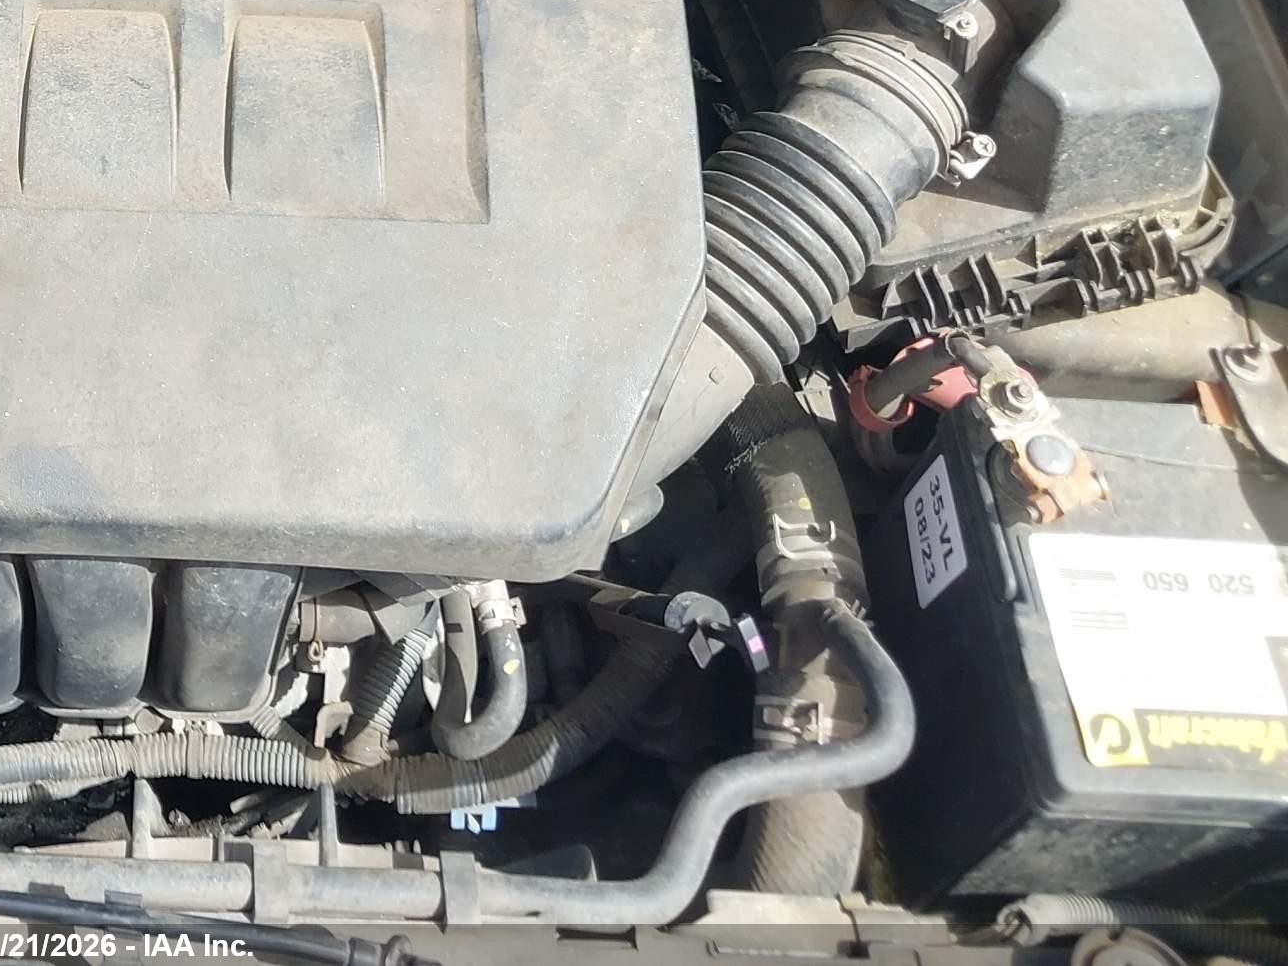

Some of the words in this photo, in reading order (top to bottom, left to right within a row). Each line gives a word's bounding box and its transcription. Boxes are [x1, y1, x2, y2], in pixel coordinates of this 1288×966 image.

[914, 496, 936, 584] 08/23
[929, 474, 954, 572] 35-VL
[1142, 569, 1190, 593] 650
[1208, 571, 1255, 595] 520
